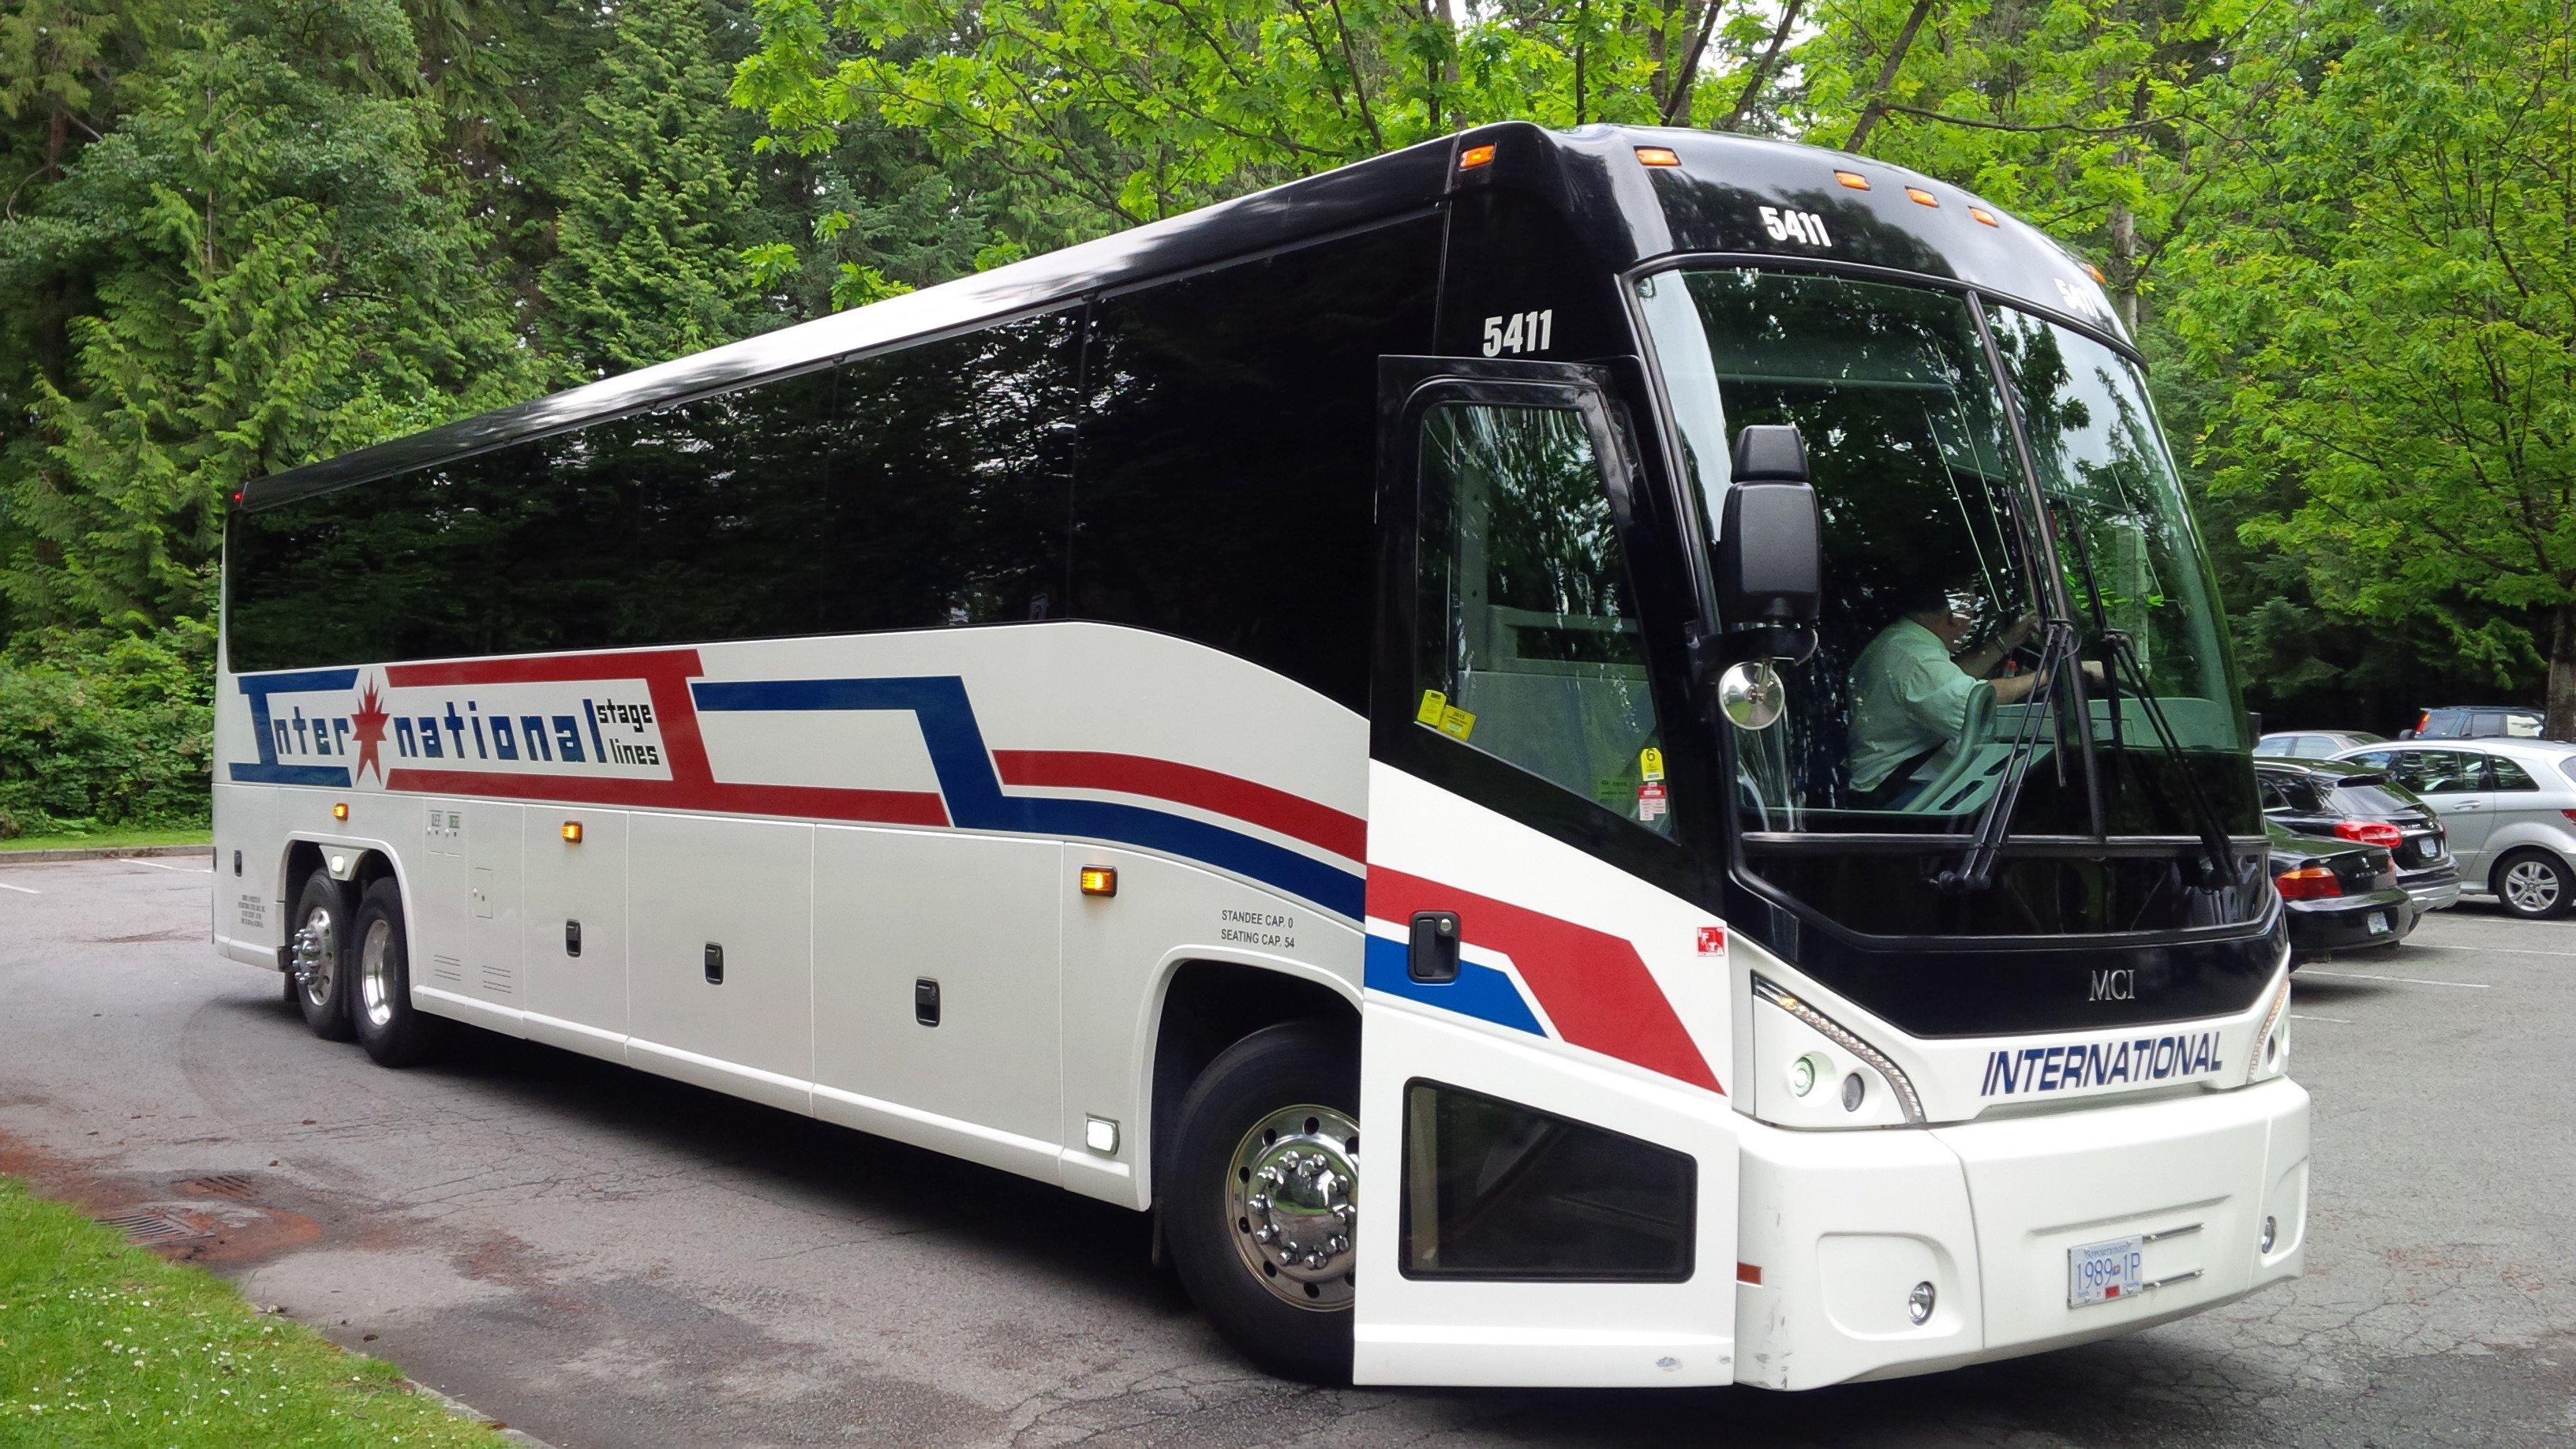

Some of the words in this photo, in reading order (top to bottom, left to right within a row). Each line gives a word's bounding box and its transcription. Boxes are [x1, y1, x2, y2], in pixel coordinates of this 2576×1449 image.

[1758, 206, 1833, 247] 5411
[1483, 309, 1552, 358] 5411
[596, 698, 653, 733] stage
[608, 738, 660, 766] lines
[1222, 909, 1264, 926] STANDEE
[1265, 915, 1286, 928] CAP.
[1288, 917, 1294, 928] 0
[1221, 928, 1260, 944] SEATING
[1261, 934, 1282, 947] CAP.
[1284, 936, 1295, 949] 54
[2089, 969, 2136, 1002] MCI
[1981, 1031, 2222, 1096] INTERNATIONAL
